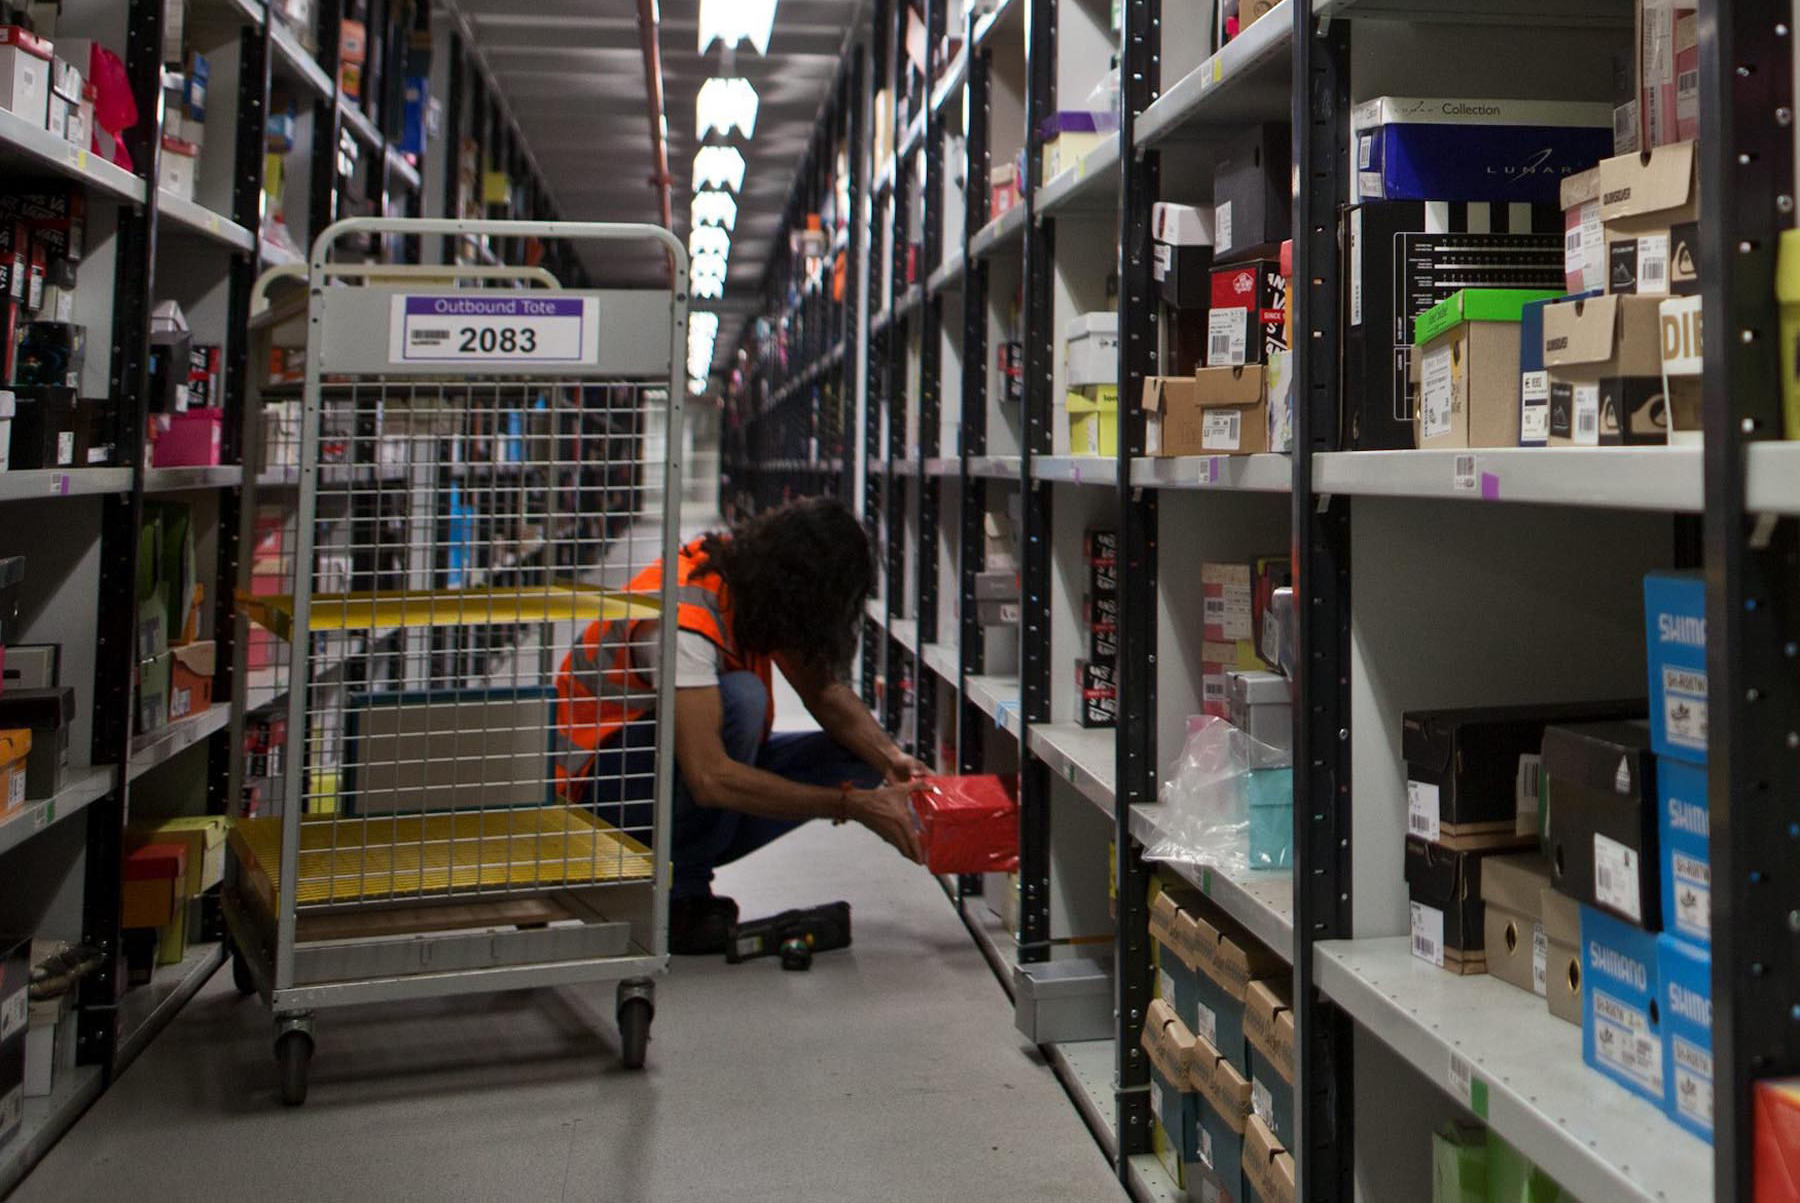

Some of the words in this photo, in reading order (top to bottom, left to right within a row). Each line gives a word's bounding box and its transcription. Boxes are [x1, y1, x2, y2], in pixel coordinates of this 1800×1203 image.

[1441, 102, 1501, 116] Collection
[434, 299, 517, 314] Outbound
[522, 300, 556, 314] Tote
[458, 327, 537, 353] 2083
[1589, 939, 1647, 993] SHIMANO
